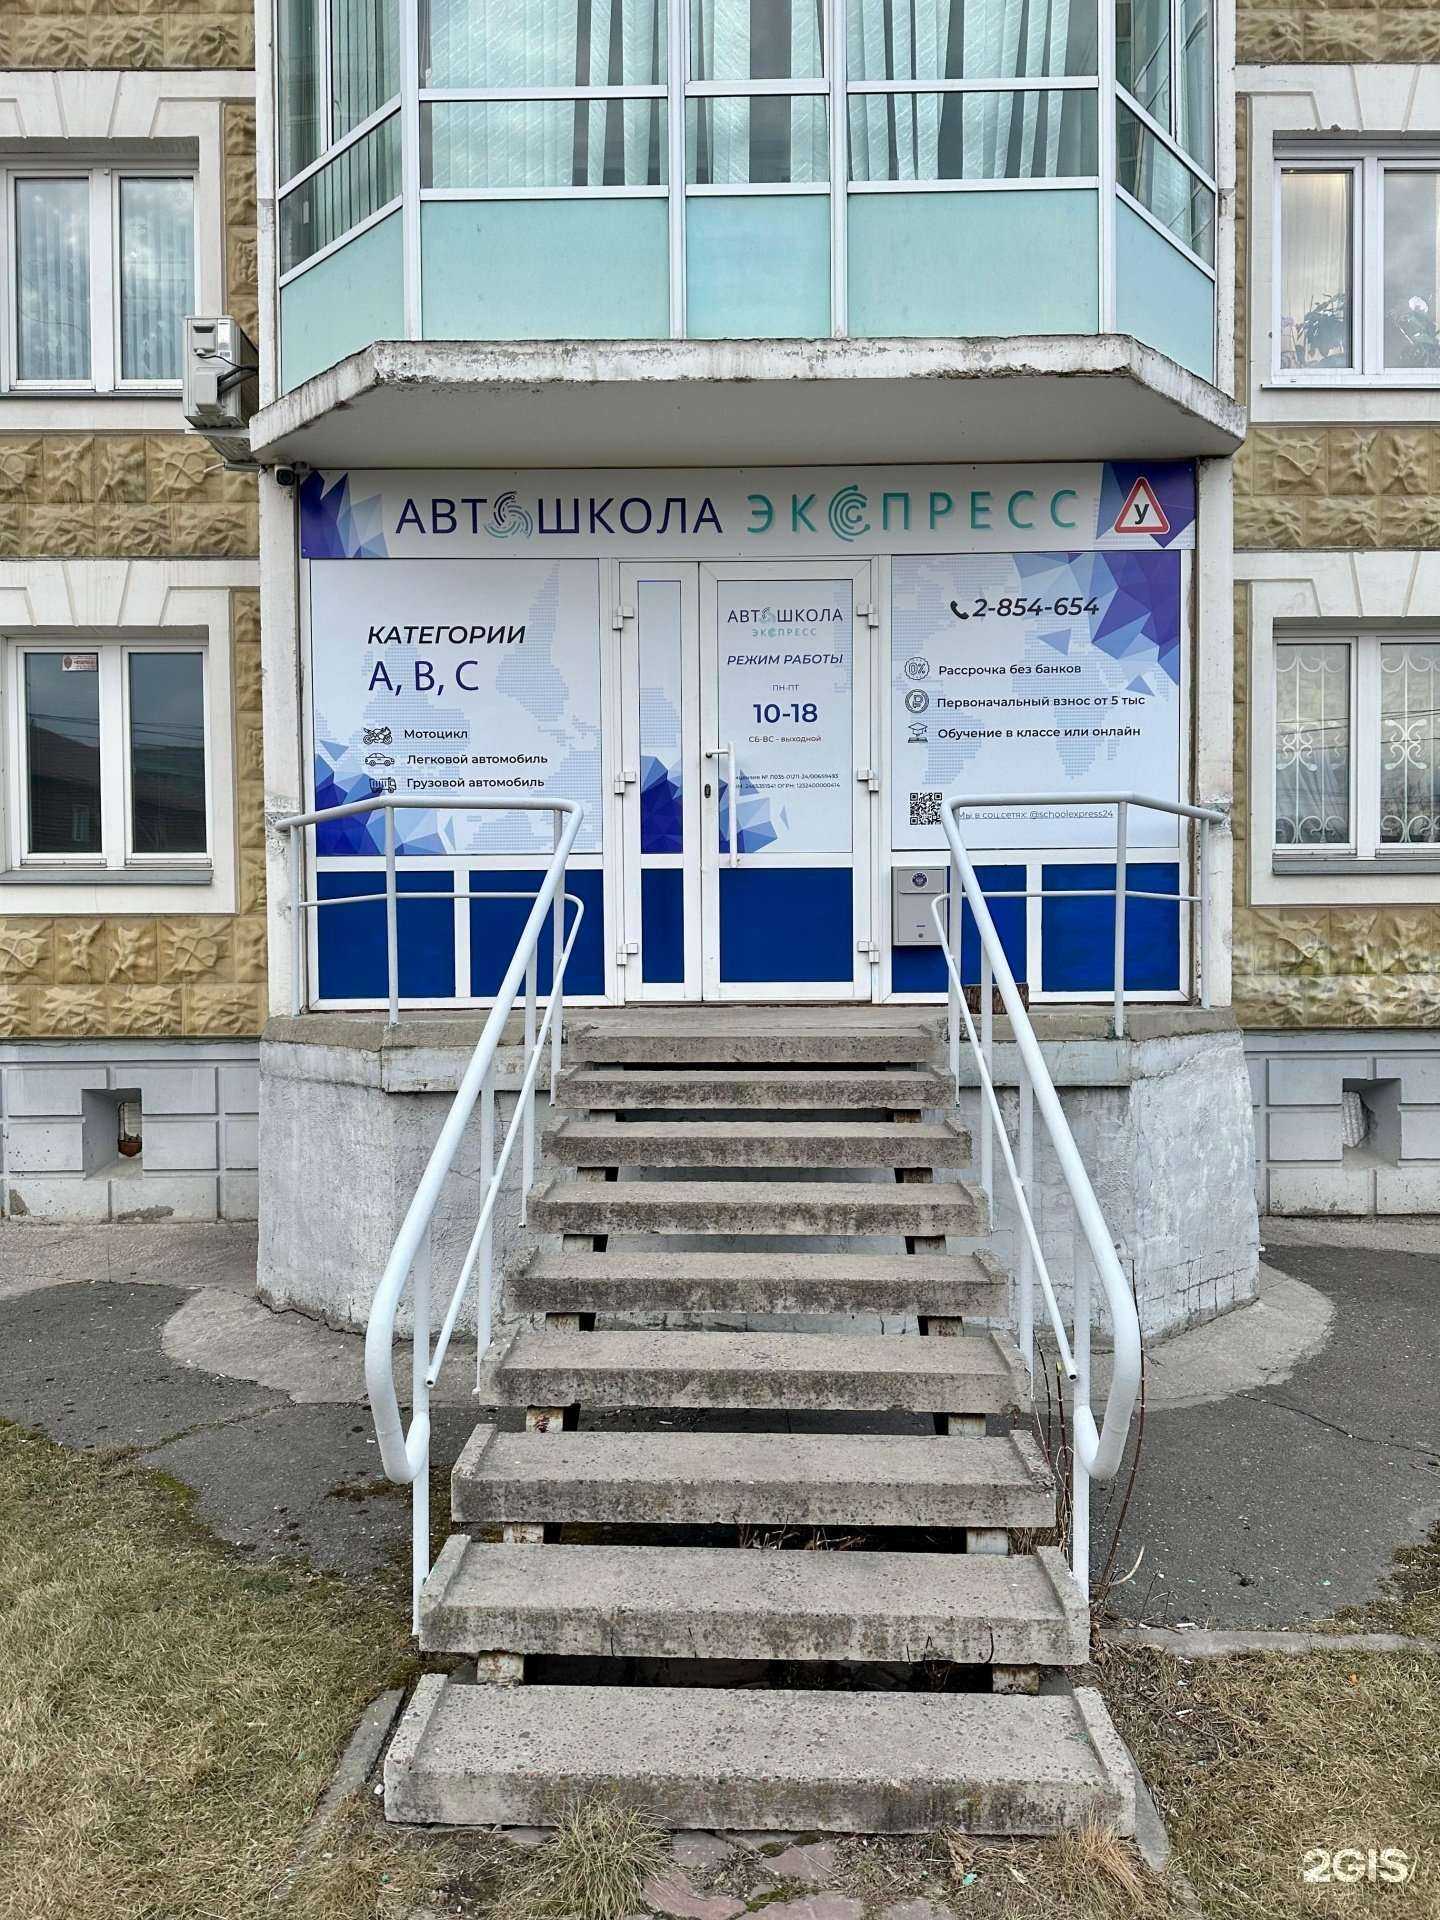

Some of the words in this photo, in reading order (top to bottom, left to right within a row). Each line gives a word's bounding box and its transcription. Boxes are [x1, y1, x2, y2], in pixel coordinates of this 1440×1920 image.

[395, 489, 724, 540] АВТОШКОЛА
[746, 484, 1078, 542] ЭКСПРЕСС
[1133, 501, 1150, 525] У
[972, 596, 1100, 618] 2-854-654
[727, 606, 844, 624] АВТОШКОЛА
[367, 625, 526, 644] КАТЕГОРИИ
[751, 627, 817, 638] ЭКСПРЕСС
[727, 655, 780, 665] РЕЖИМ
[783, 654, 844, 664] РАБОТЫ
[938, 666, 1006, 677] Рассрочка
[1009, 664, 1032, 674] без
[1035, 664, 1082, 674] банков
[937, 696, 1050, 710] Первоначальный
[1053, 698, 1091, 706] взнос
[1093, 697, 1108, 705] от
[1111, 696, 1119, 705] 5
[1121, 697, 1146, 705] тыс
[753, 703, 818, 723] 10-18
[404, 729, 468, 739] Мотоцикл
[781, 735, 822, 743] выходной
[937, 728, 1002, 740] Обучение
[1016, 729, 1060, 737] классе
[1064, 728, 1089, 737] или
[1092, 726, 1141, 737] онлайн
[407, 754, 468, 764] Легковой
[471, 754, 548, 764] автомобиль
[407, 778, 465, 789] Грузовой
[468, 778, 545, 787] автомобиль
[1030, 809, 1113, 819] @schoolexpress24
